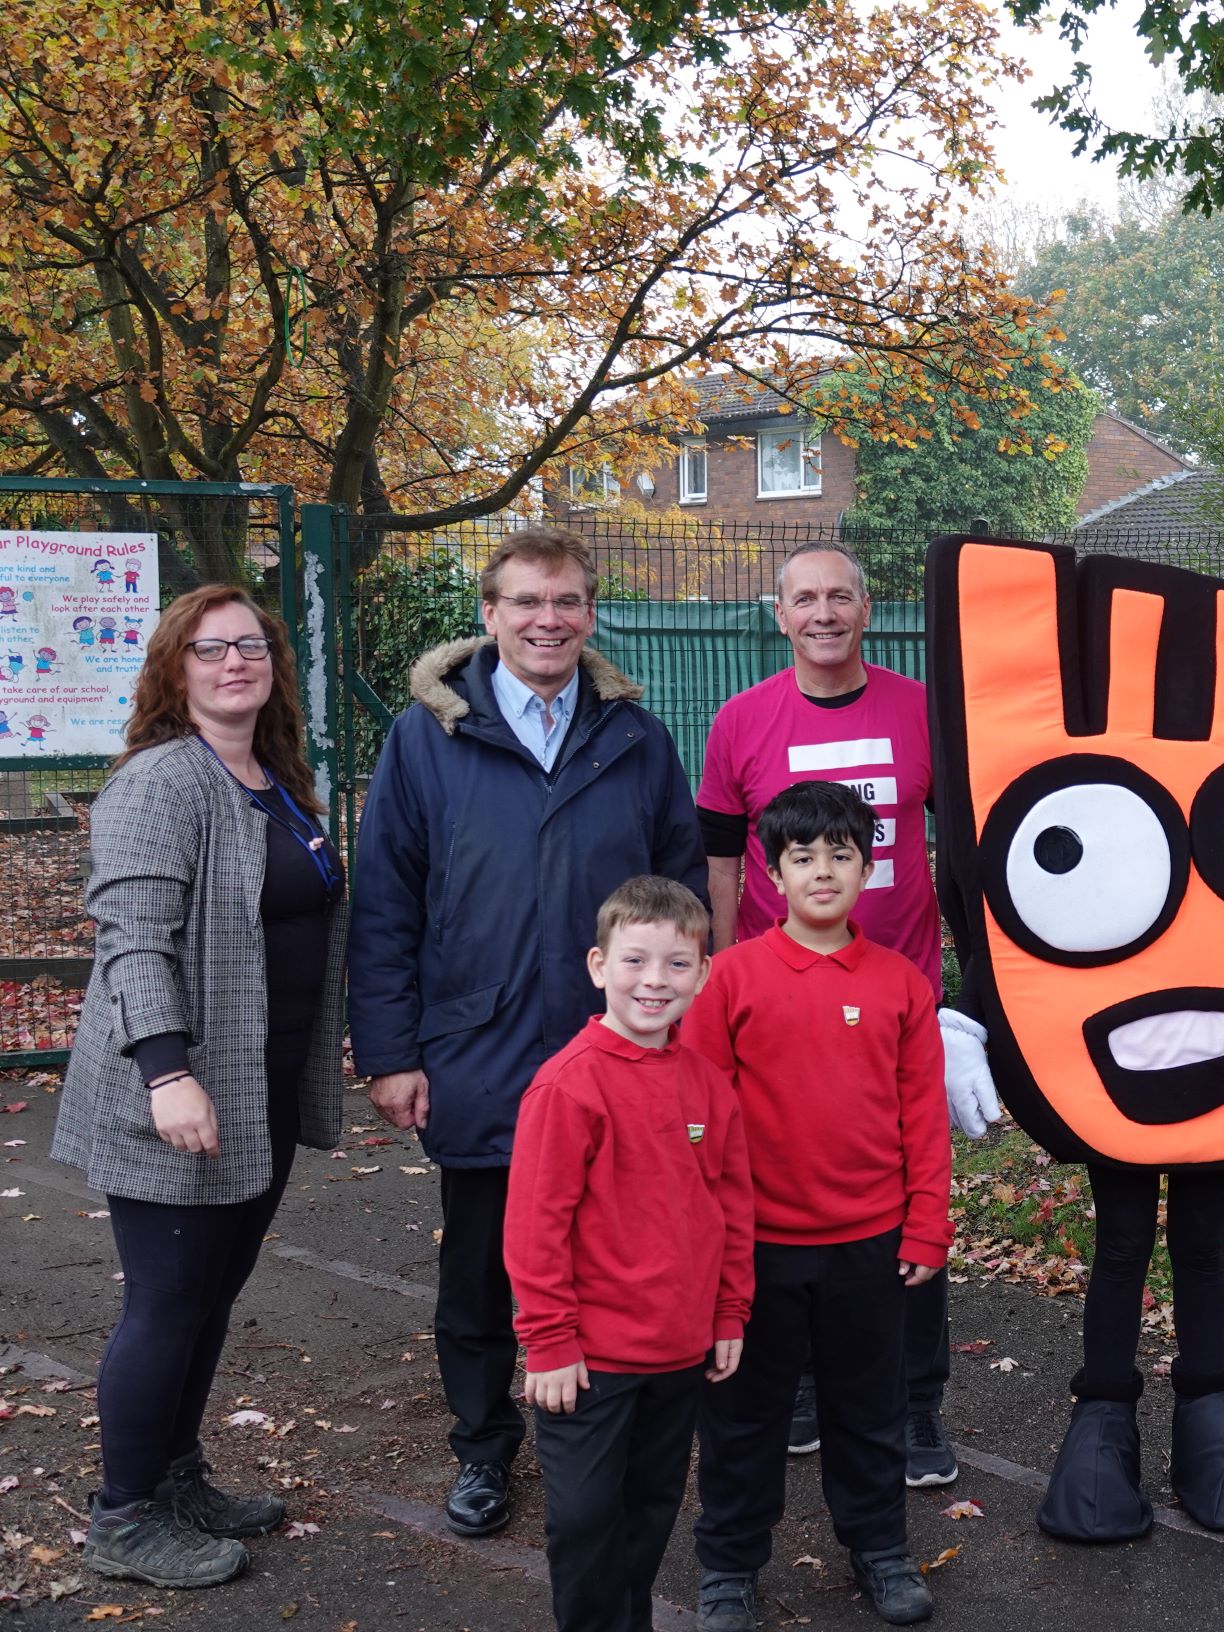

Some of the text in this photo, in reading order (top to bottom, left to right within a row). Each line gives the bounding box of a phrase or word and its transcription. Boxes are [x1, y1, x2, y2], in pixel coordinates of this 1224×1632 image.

[16, 536, 102, 557] Playground
[106, 542, 146, 556] Rules
[17, 565, 36, 573] kind
[40, 565, 55, 573] and
[28, 576, 70, 584] everyone
[62, 595, 78, 603] We
[80, 595, 100, 604] play
[102, 595, 131, 604] safely
[52, 604, 70, 612] look
[73, 604, 98, 612] after
[85, 655, 100, 663] We
[3, 686, 24, 694] take
[50, 685, 60, 694] of
[81, 684, 111, 696] school,
[38, 695, 55, 703] and
[57, 695, 104, 705] equipment
[70, 718, 86, 726] We
